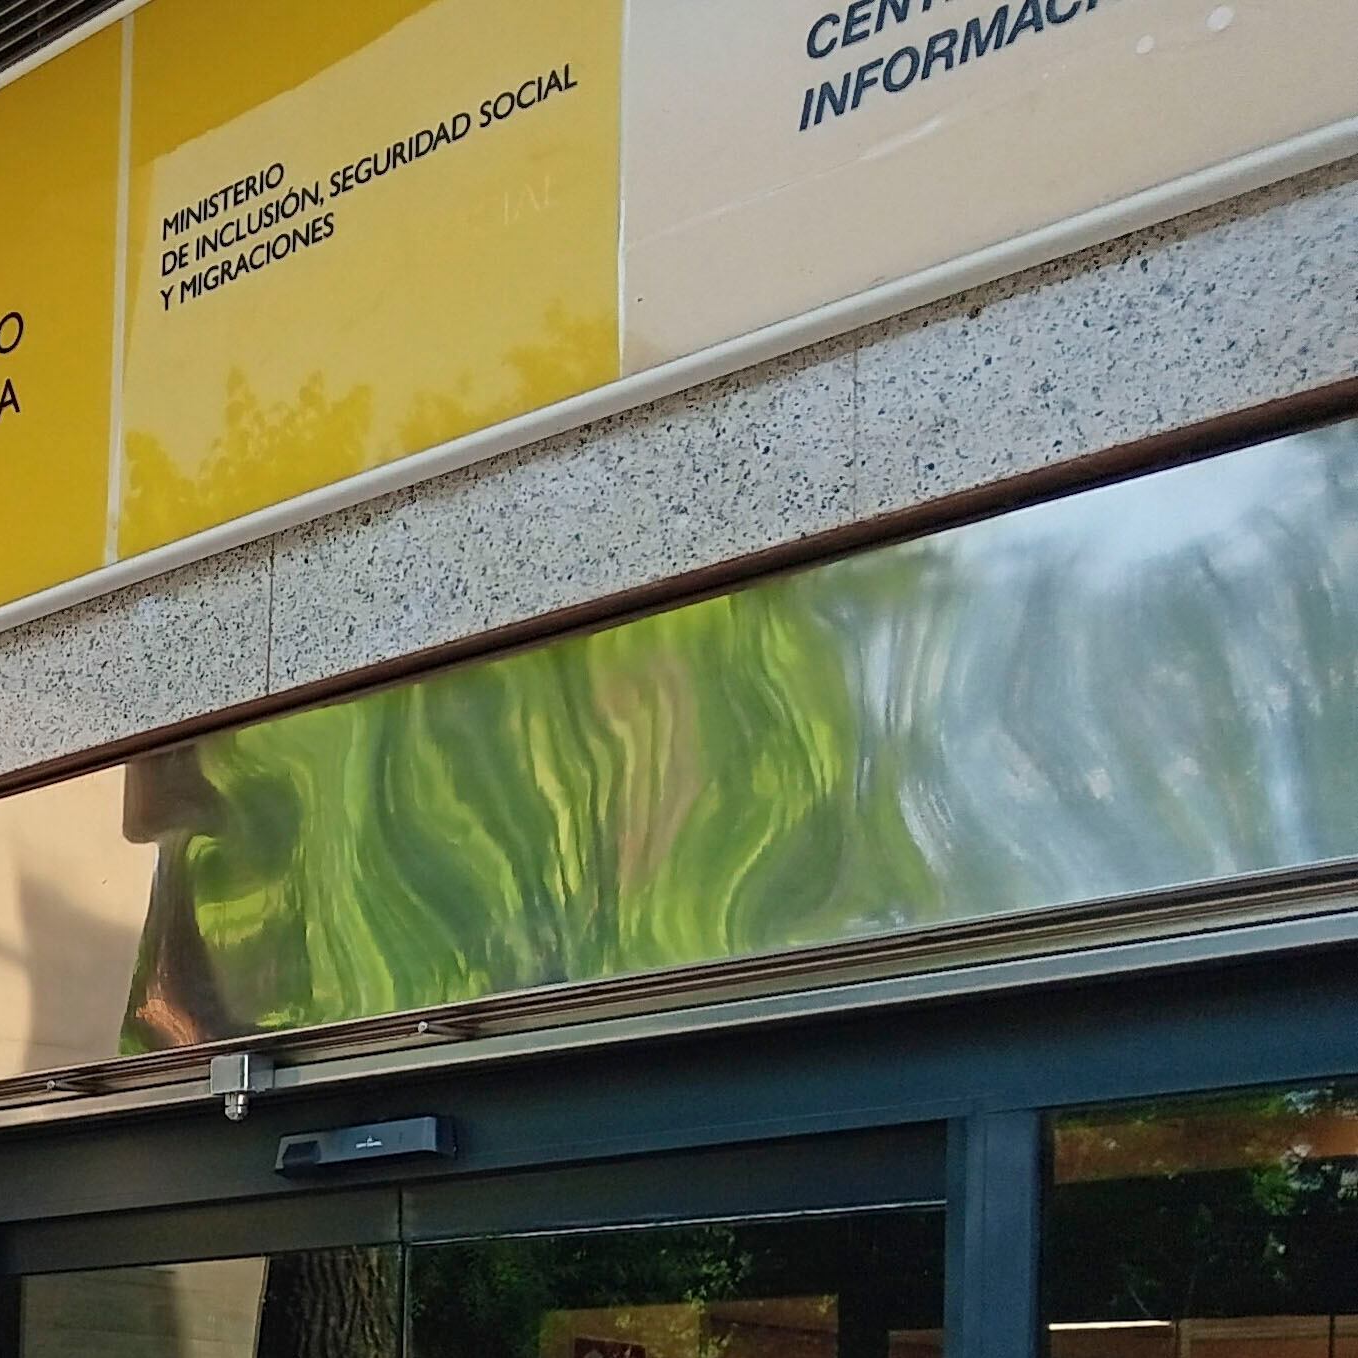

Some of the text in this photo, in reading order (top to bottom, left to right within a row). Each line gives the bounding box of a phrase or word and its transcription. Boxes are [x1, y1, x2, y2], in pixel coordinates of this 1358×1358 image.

[806, 0, 951, 59] CEN
[161, 63, 578, 276] DE INCLUSIÓN, SEGURIDAD SOCIAL
[162, 162, 285, 241] MINISTERIO
[160, 212, 335, 311] Y MIGRACIONES
